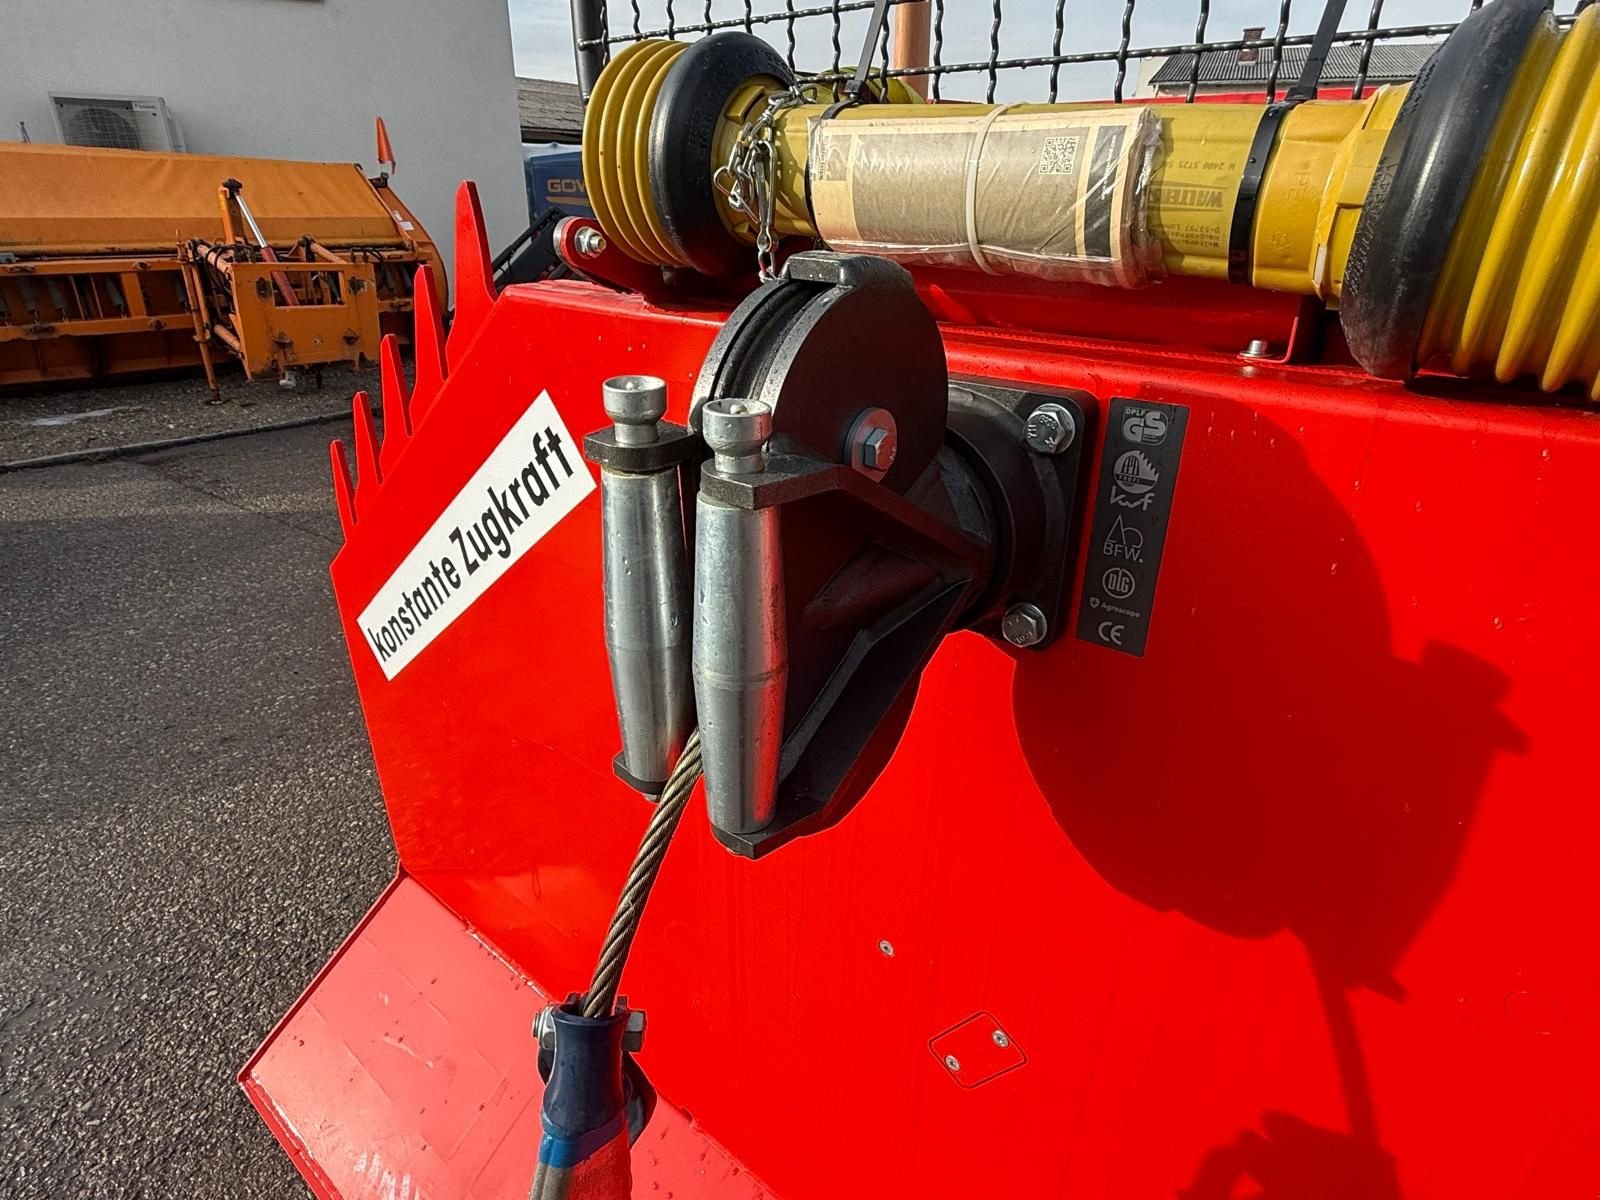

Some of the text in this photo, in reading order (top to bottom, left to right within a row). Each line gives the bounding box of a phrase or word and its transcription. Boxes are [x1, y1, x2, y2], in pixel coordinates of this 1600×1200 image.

[1123, 411, 1166, 442] GS
[367, 425, 574, 663] konstante Zugkraft
[1108, 569, 1130, 593] DLG
[1101, 602, 1140, 618] Agroscope
[1098, 621, 1125, 646] CE
